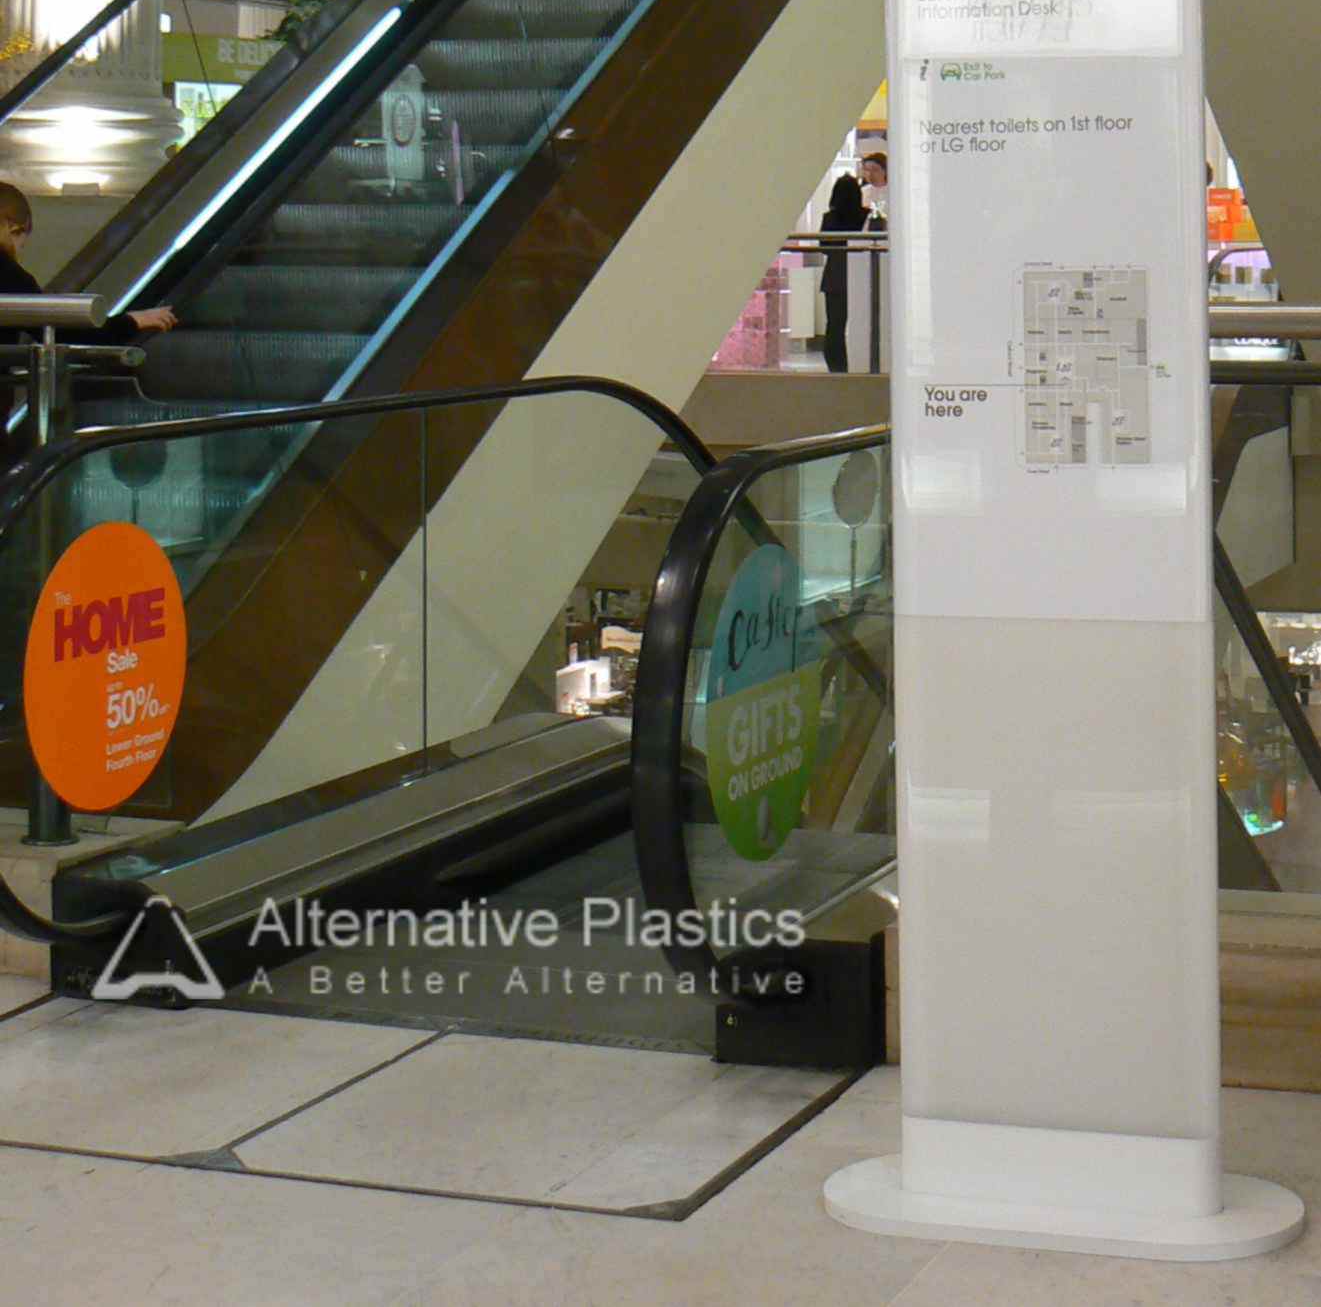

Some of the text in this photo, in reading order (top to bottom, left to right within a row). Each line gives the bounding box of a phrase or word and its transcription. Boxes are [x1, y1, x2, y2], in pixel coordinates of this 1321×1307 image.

[917, 0, 1059, 20] Information Desk
[919, 113, 1133, 136] Nearest toilets on 1st floor
[919, 135, 1007, 154] or LG floor
[924, 385, 988, 402] You are
[924, 401, 965, 418] here
[54, 590, 74, 607] The
[53, 586, 167, 663] HOME
[106, 648, 139, 675] Sale
[727, 685, 804, 767] GIFTS
[727, 744, 804, 802] ON GROUND
